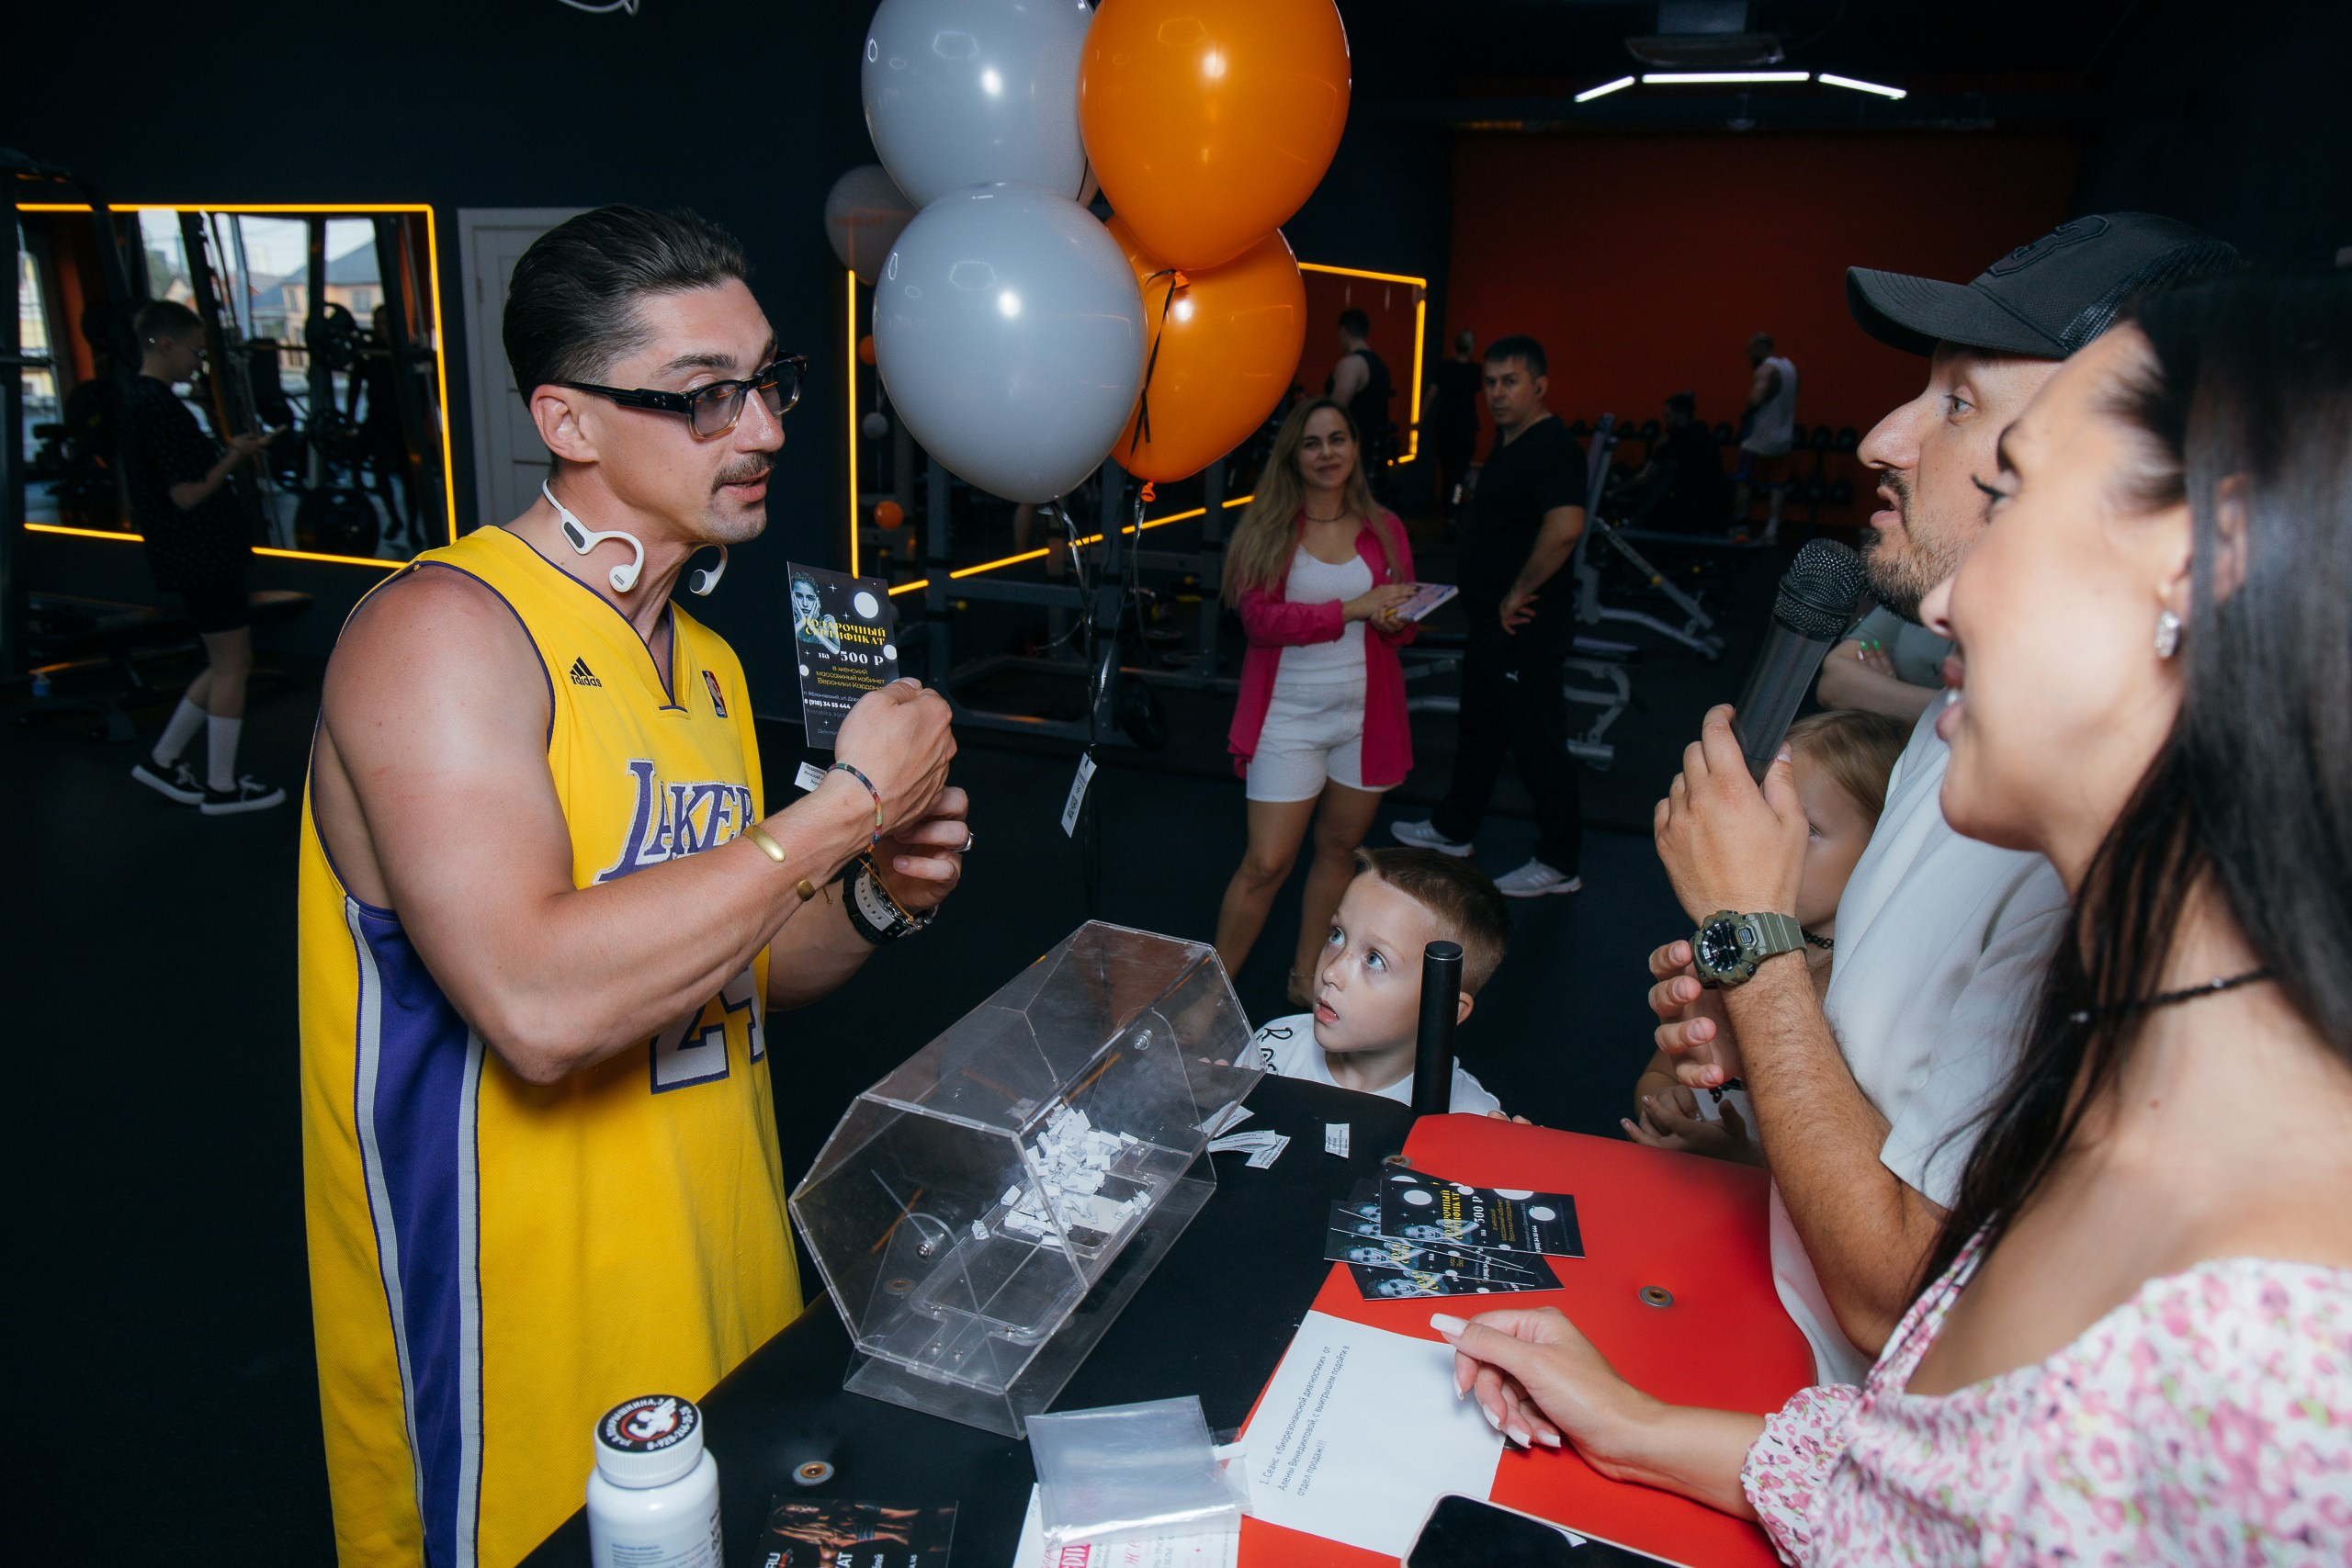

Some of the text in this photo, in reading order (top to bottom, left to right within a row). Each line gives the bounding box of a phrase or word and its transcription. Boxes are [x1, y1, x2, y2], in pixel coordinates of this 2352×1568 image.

[840, 650, 868, 664] 500
[1472, 1205, 1485, 1224] 500
[1263, 1457, 1280, 1478] Сеанс
[1323, 1346, 1331, 1354] от
[1277, 1467, 1295, 1491] Алены
[1315, 1375, 1336, 1413] выигрышем
[1331, 1349, 1347, 1376] подойти
[1297, 1439, 1328, 1496] отдел продаж!!!
